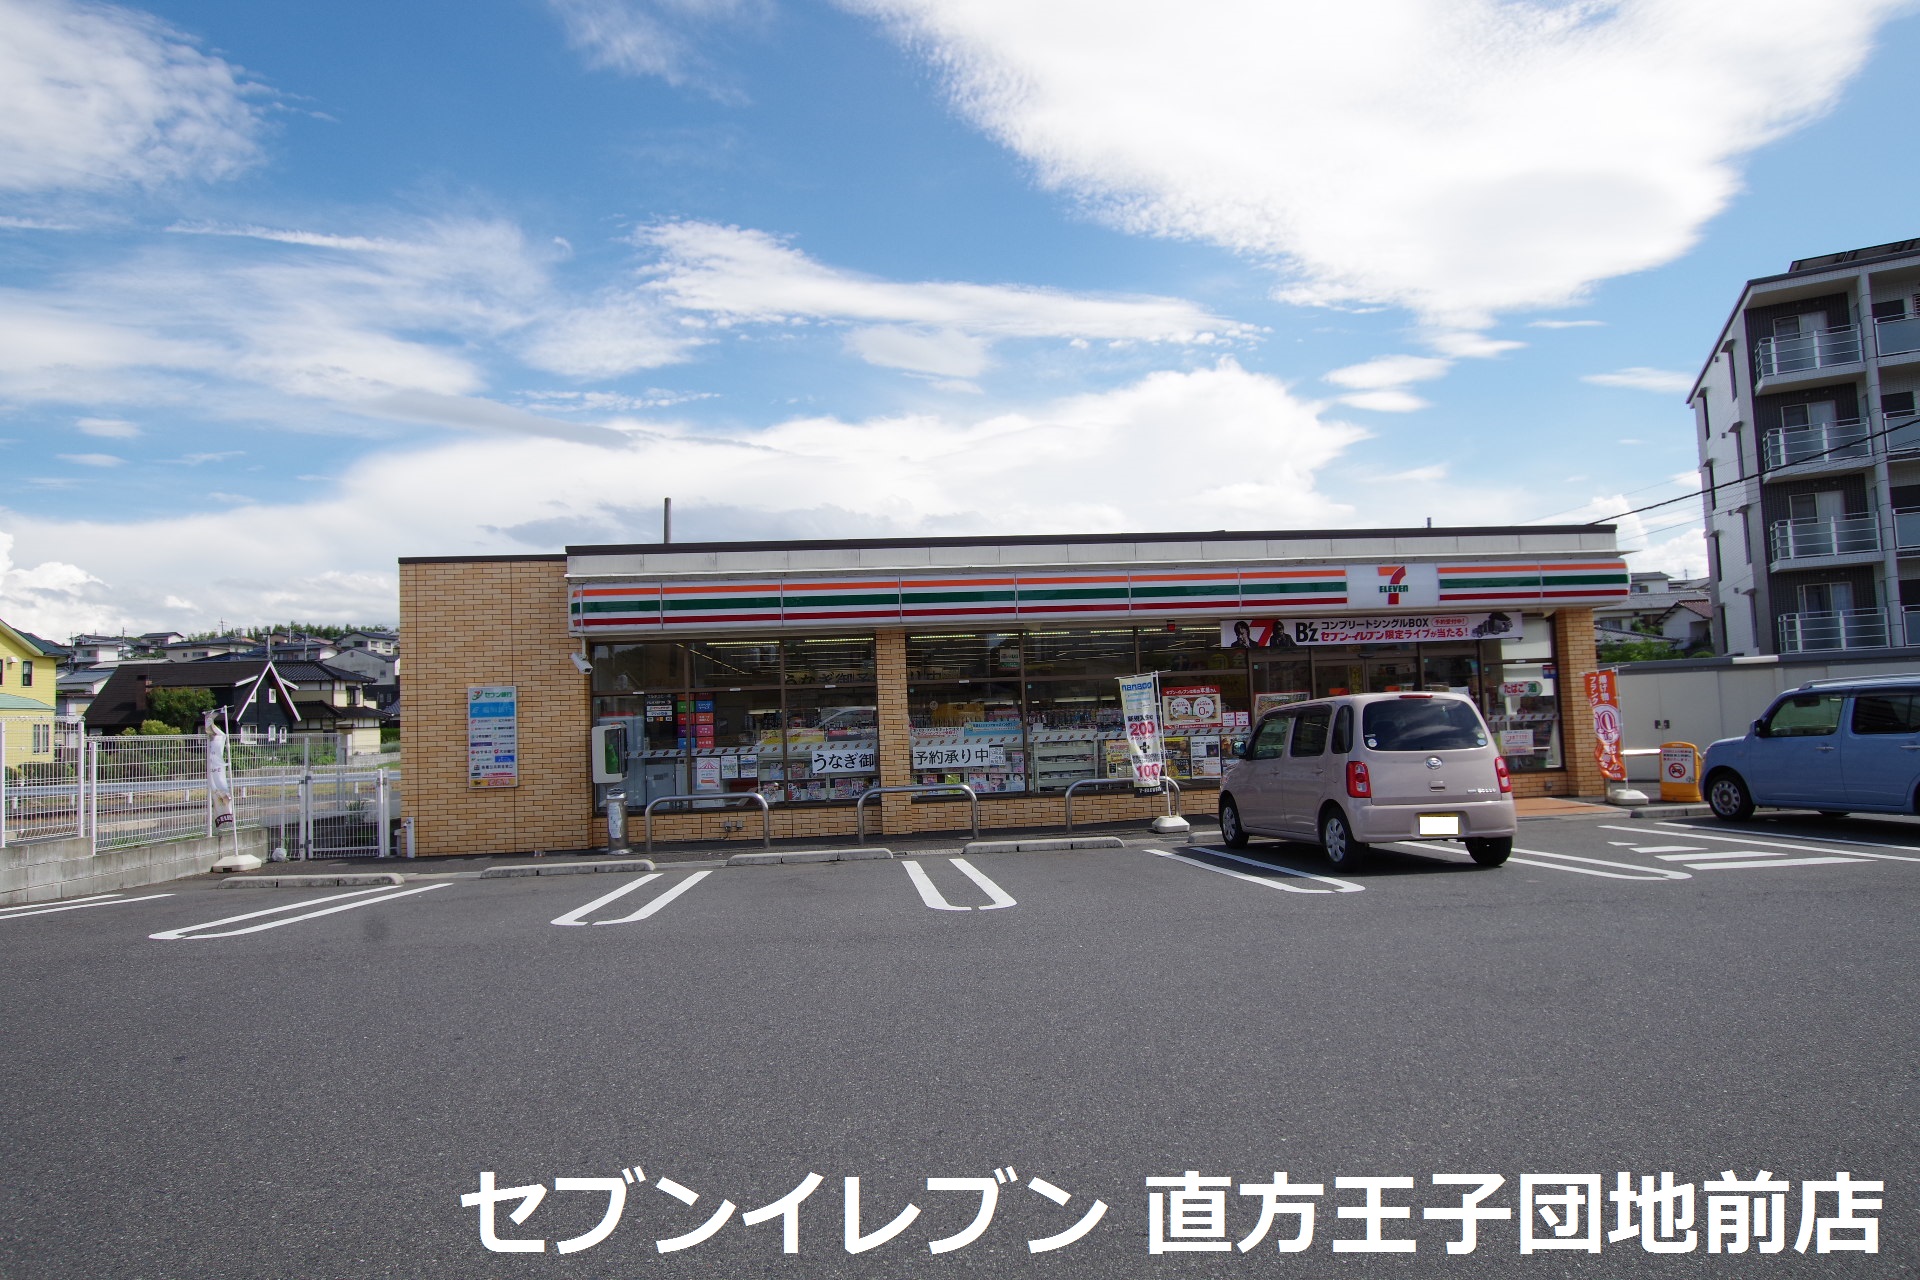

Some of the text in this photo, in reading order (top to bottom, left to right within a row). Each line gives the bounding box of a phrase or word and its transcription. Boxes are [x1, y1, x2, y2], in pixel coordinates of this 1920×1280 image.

[1295, 621, 1319, 643] B'z
[1320, 617, 1429, 631] コンプリートシングルBOX
[1121, 681, 1153, 692] nanaco
[1503, 683, 1525, 694] たばこ
[1129, 721, 1156, 737] 200
[812, 751, 875, 772] うなぎ御
[913, 747, 989, 766] 予約承り中
